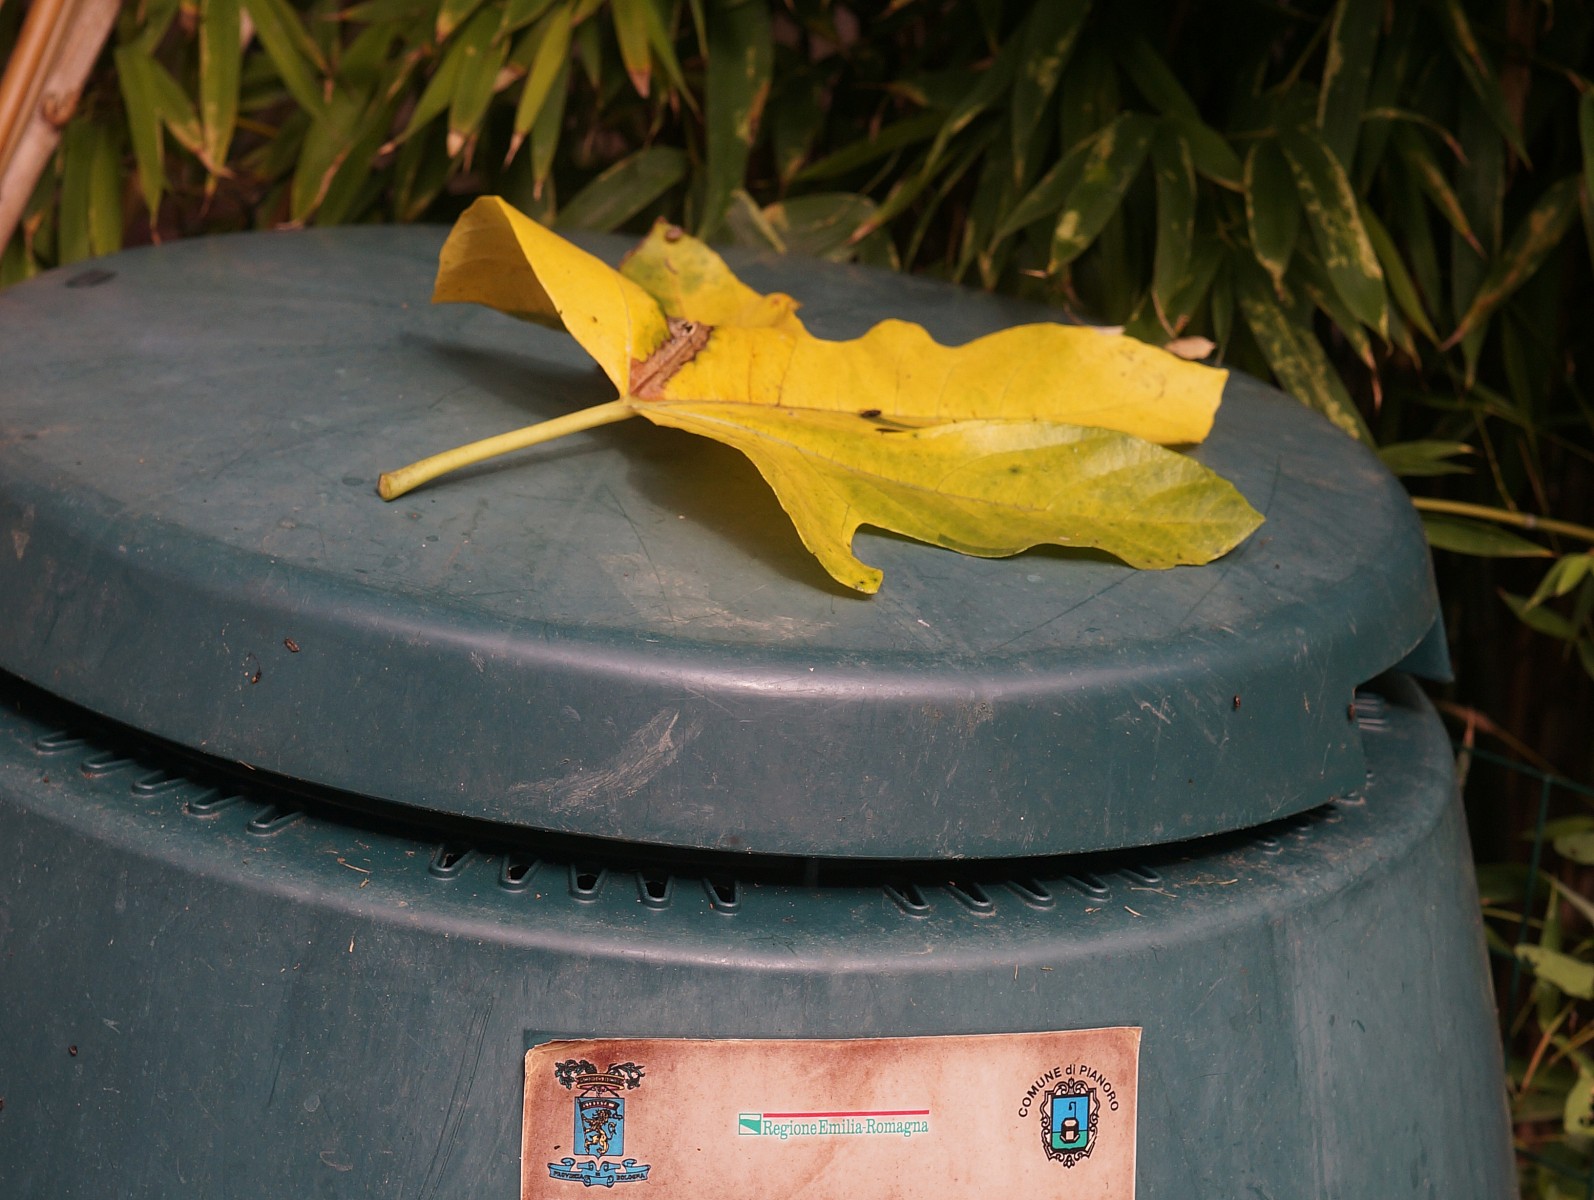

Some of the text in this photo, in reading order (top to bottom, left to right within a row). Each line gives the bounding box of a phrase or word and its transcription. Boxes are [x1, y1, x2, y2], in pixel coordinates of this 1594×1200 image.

[1018, 1064, 1119, 1118] COMUNE di PIANORO
[763, 1118, 929, 1140] Regione Emilia-Romagna
